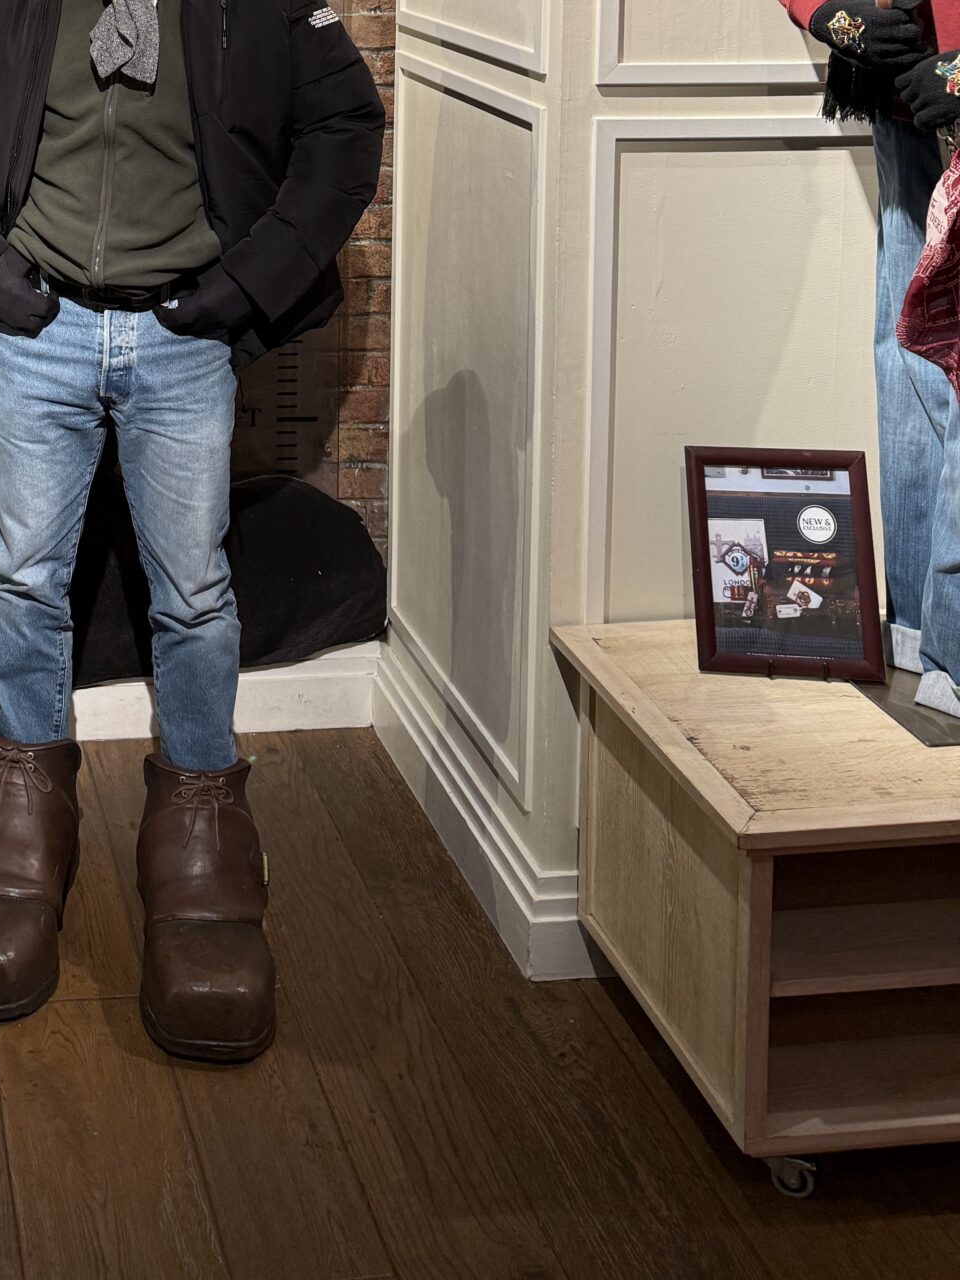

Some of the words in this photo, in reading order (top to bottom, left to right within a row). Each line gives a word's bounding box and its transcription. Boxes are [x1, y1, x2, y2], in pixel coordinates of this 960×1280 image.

[802, 517, 822, 526] NEW
[824, 518, 832, 528] &
[802, 524, 832, 532] EXCLUSIVE
